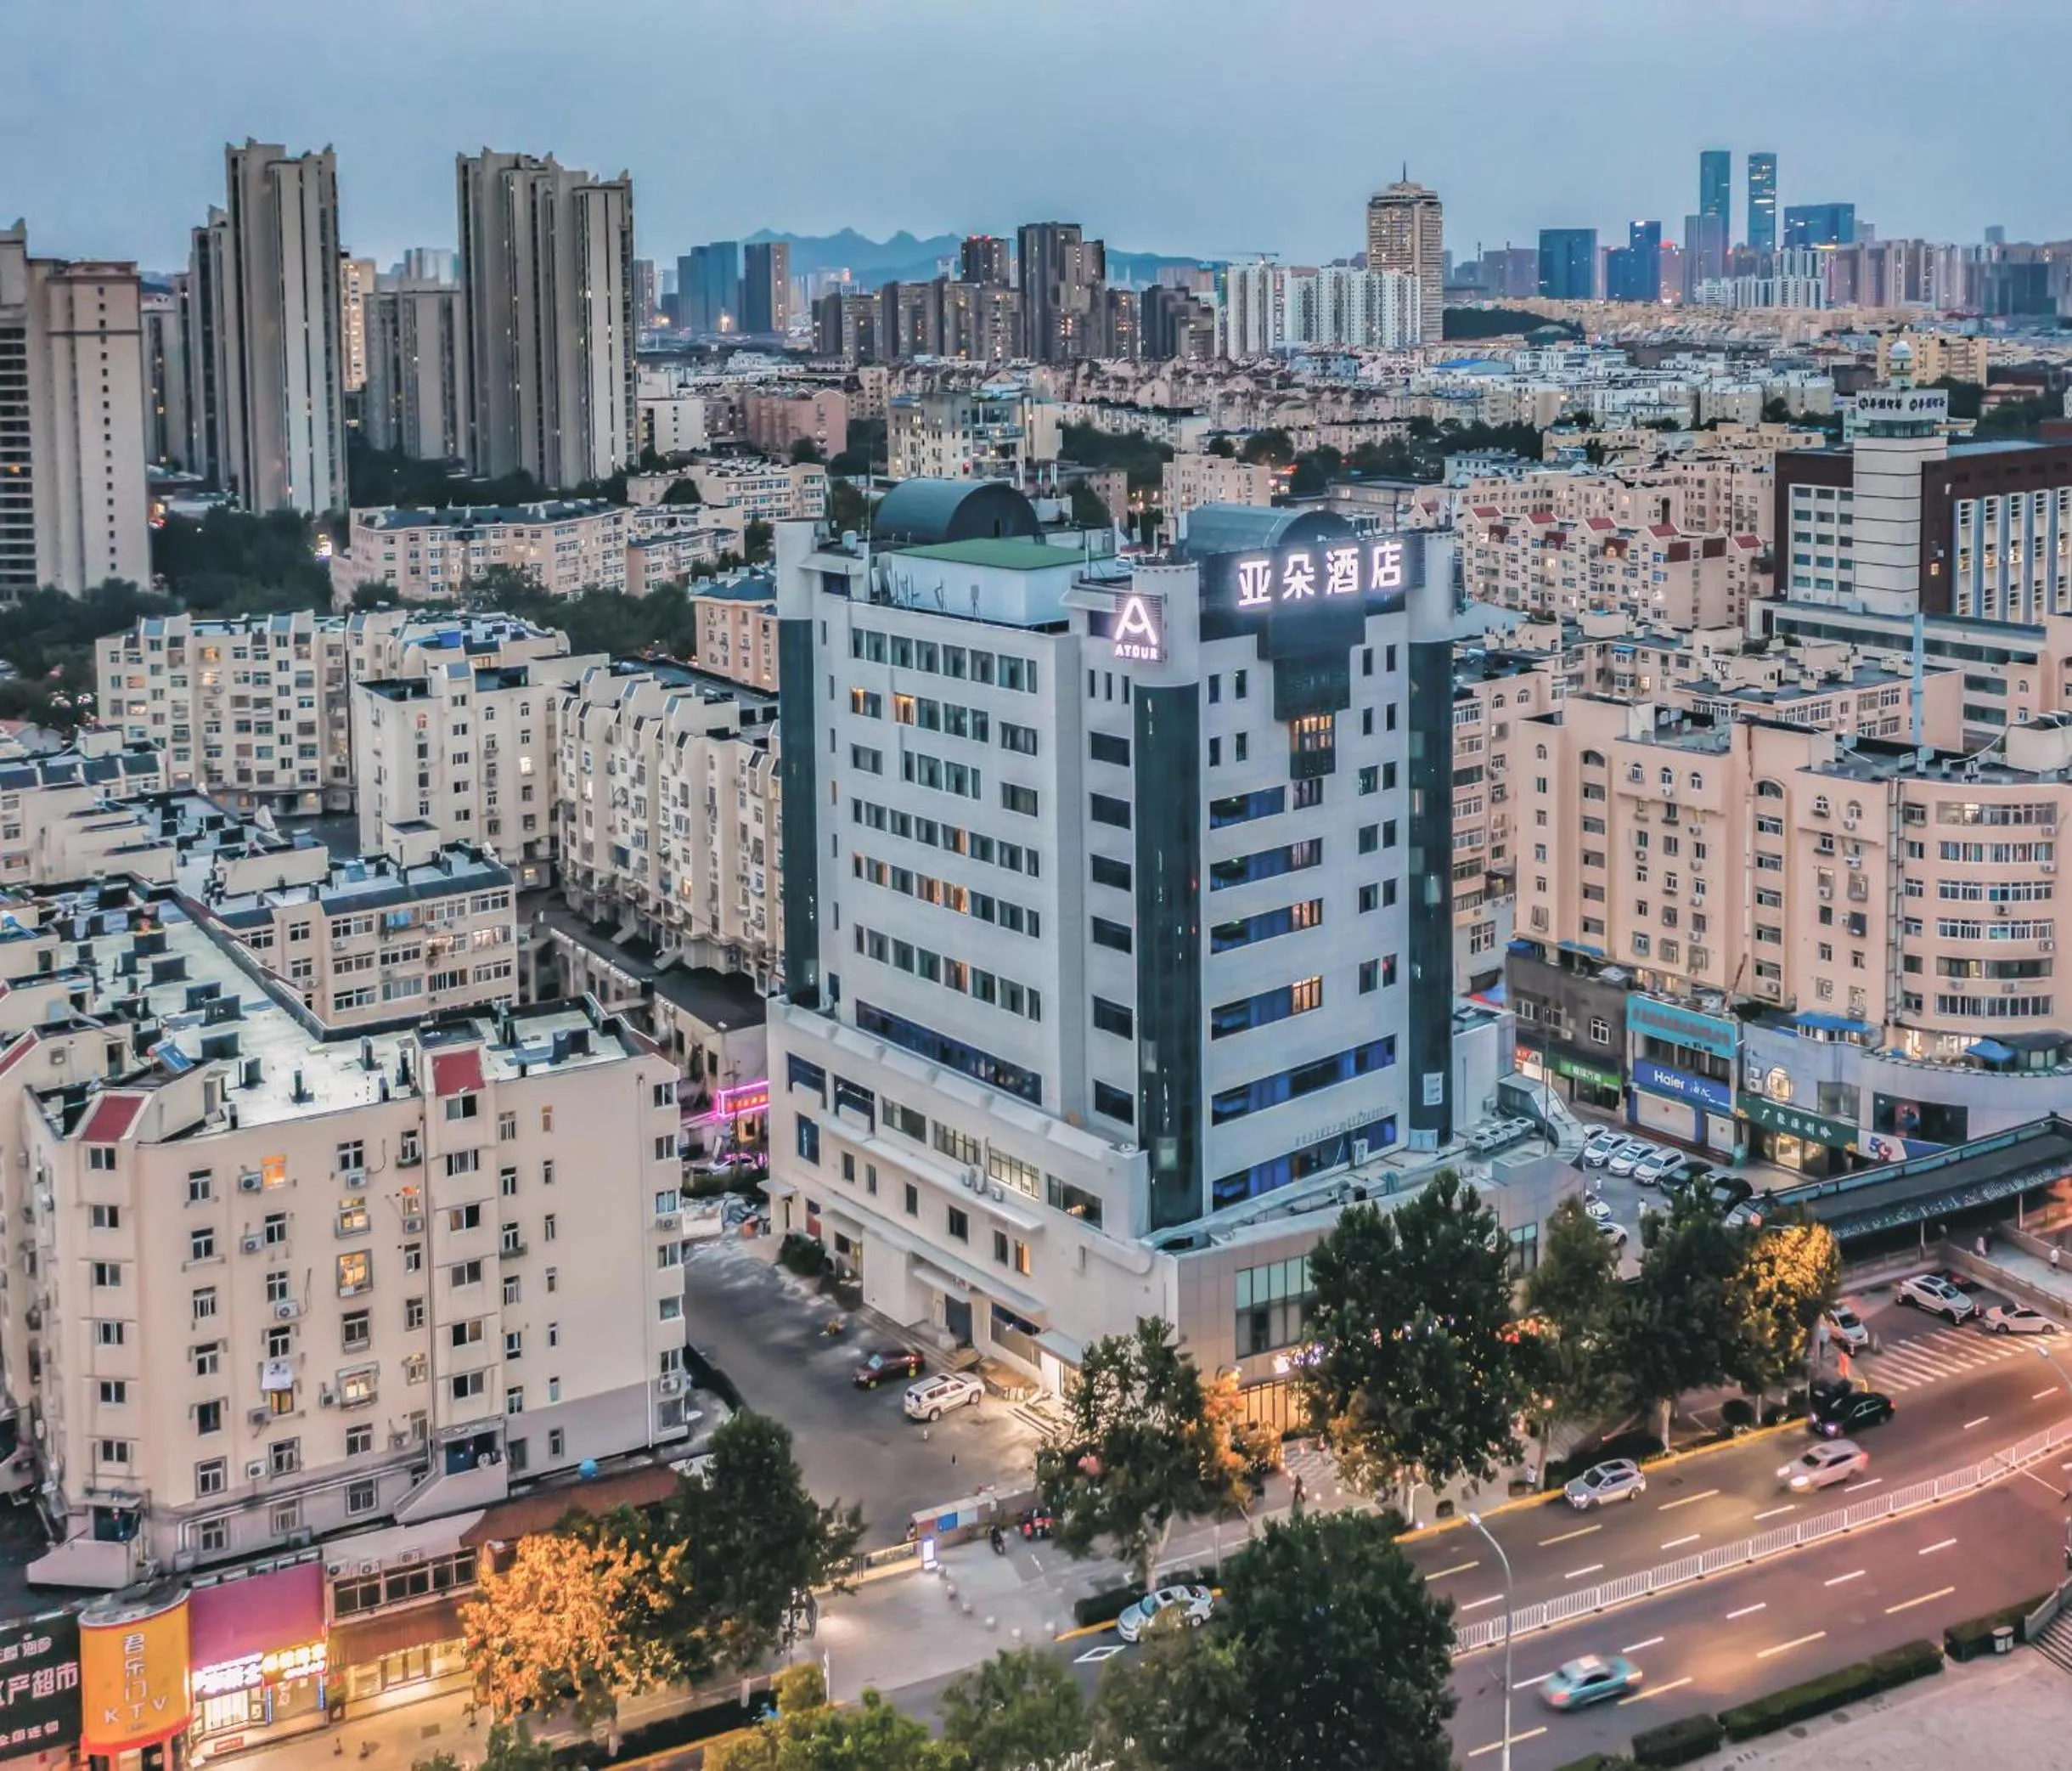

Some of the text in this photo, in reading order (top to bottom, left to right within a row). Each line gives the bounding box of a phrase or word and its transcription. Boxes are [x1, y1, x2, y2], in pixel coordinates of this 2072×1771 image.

[1238, 541, 1403, 606] 亚朵酒店
[1115, 643, 1157, 660] ATOUR
[1653, 1069, 1686, 1090] Haier
[0, 1661, 79, 1707] 产超市
[104, 1695, 167, 1724] KTV
